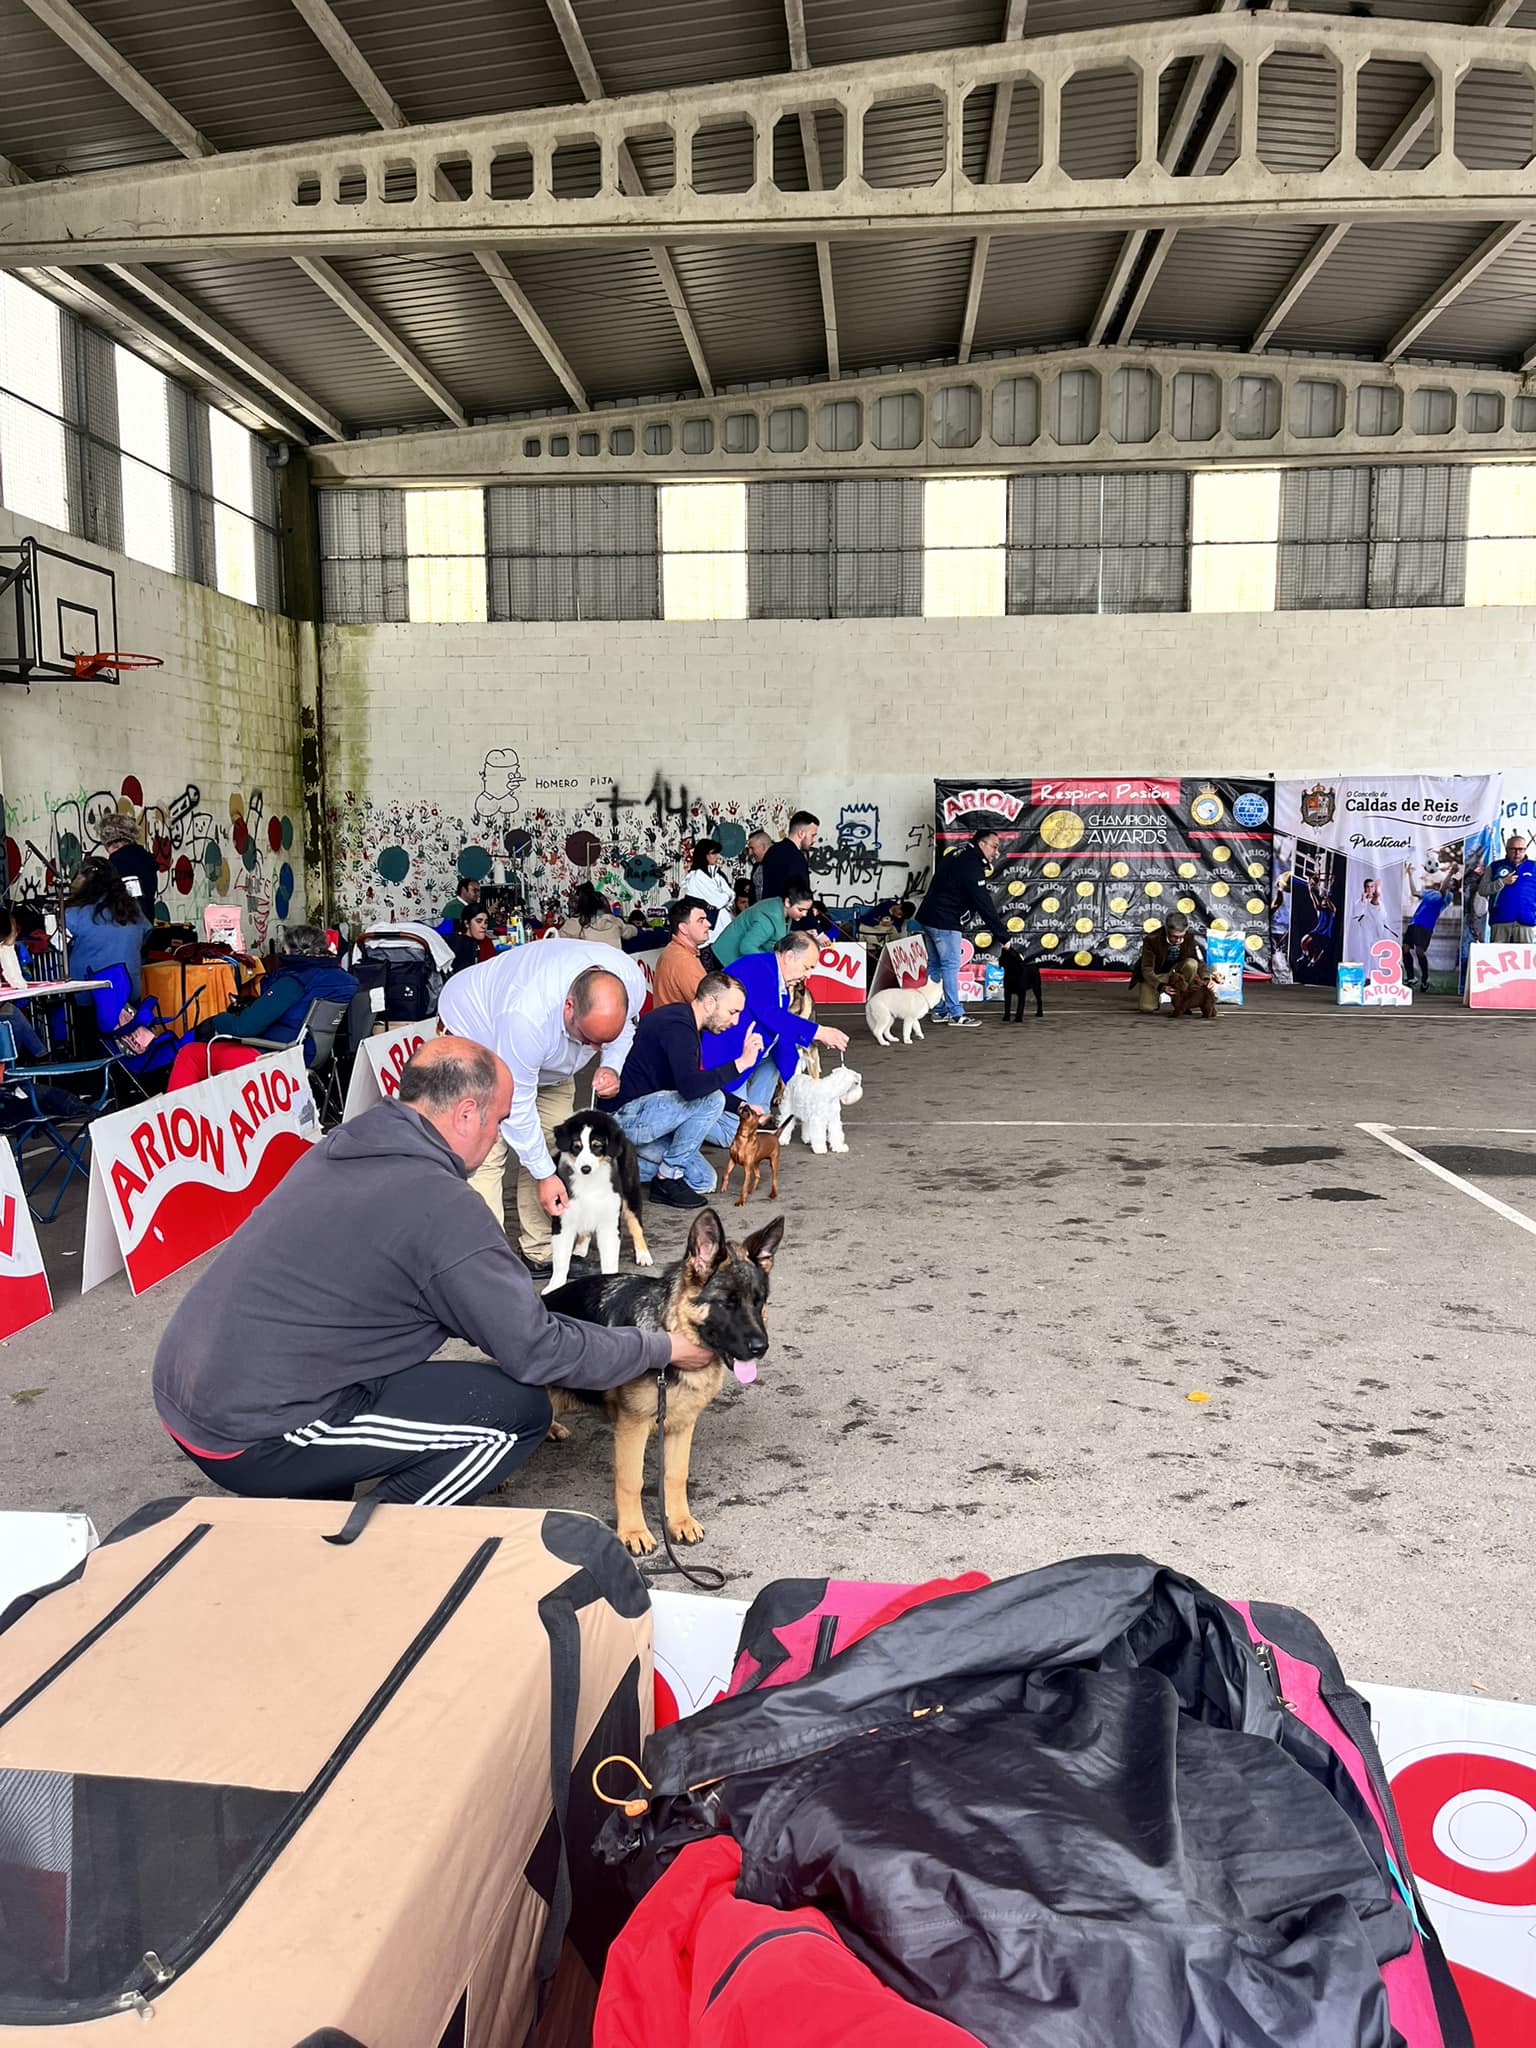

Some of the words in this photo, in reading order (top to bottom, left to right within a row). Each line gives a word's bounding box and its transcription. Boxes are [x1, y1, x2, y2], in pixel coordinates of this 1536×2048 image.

[535, 776, 579, 789] HOMERO
[1040, 784, 1108, 806] Respira
[1116, 783, 1170, 800] Pasión
[1380, 790, 1388, 798] de
[943, 788, 1024, 824] ARION
[1345, 798, 1397, 812] Caldas
[1401, 798, 1420, 812] de
[1423, 798, 1459, 813] Reis
[1088, 814, 1167, 826] CHAMPIONS
[1422, 814, 1434, 822] co
[1435, 813, 1471, 824] deporte
[1088, 830, 1167, 844] AWARDS
[1370, 940, 1402, 985] 3
[1476, 949, 1536, 984] ARI
[1364, 983, 1410, 1000] ARION
[110, 1107, 226, 1231] ARION
[229, 1068, 300, 1168] ARIO
